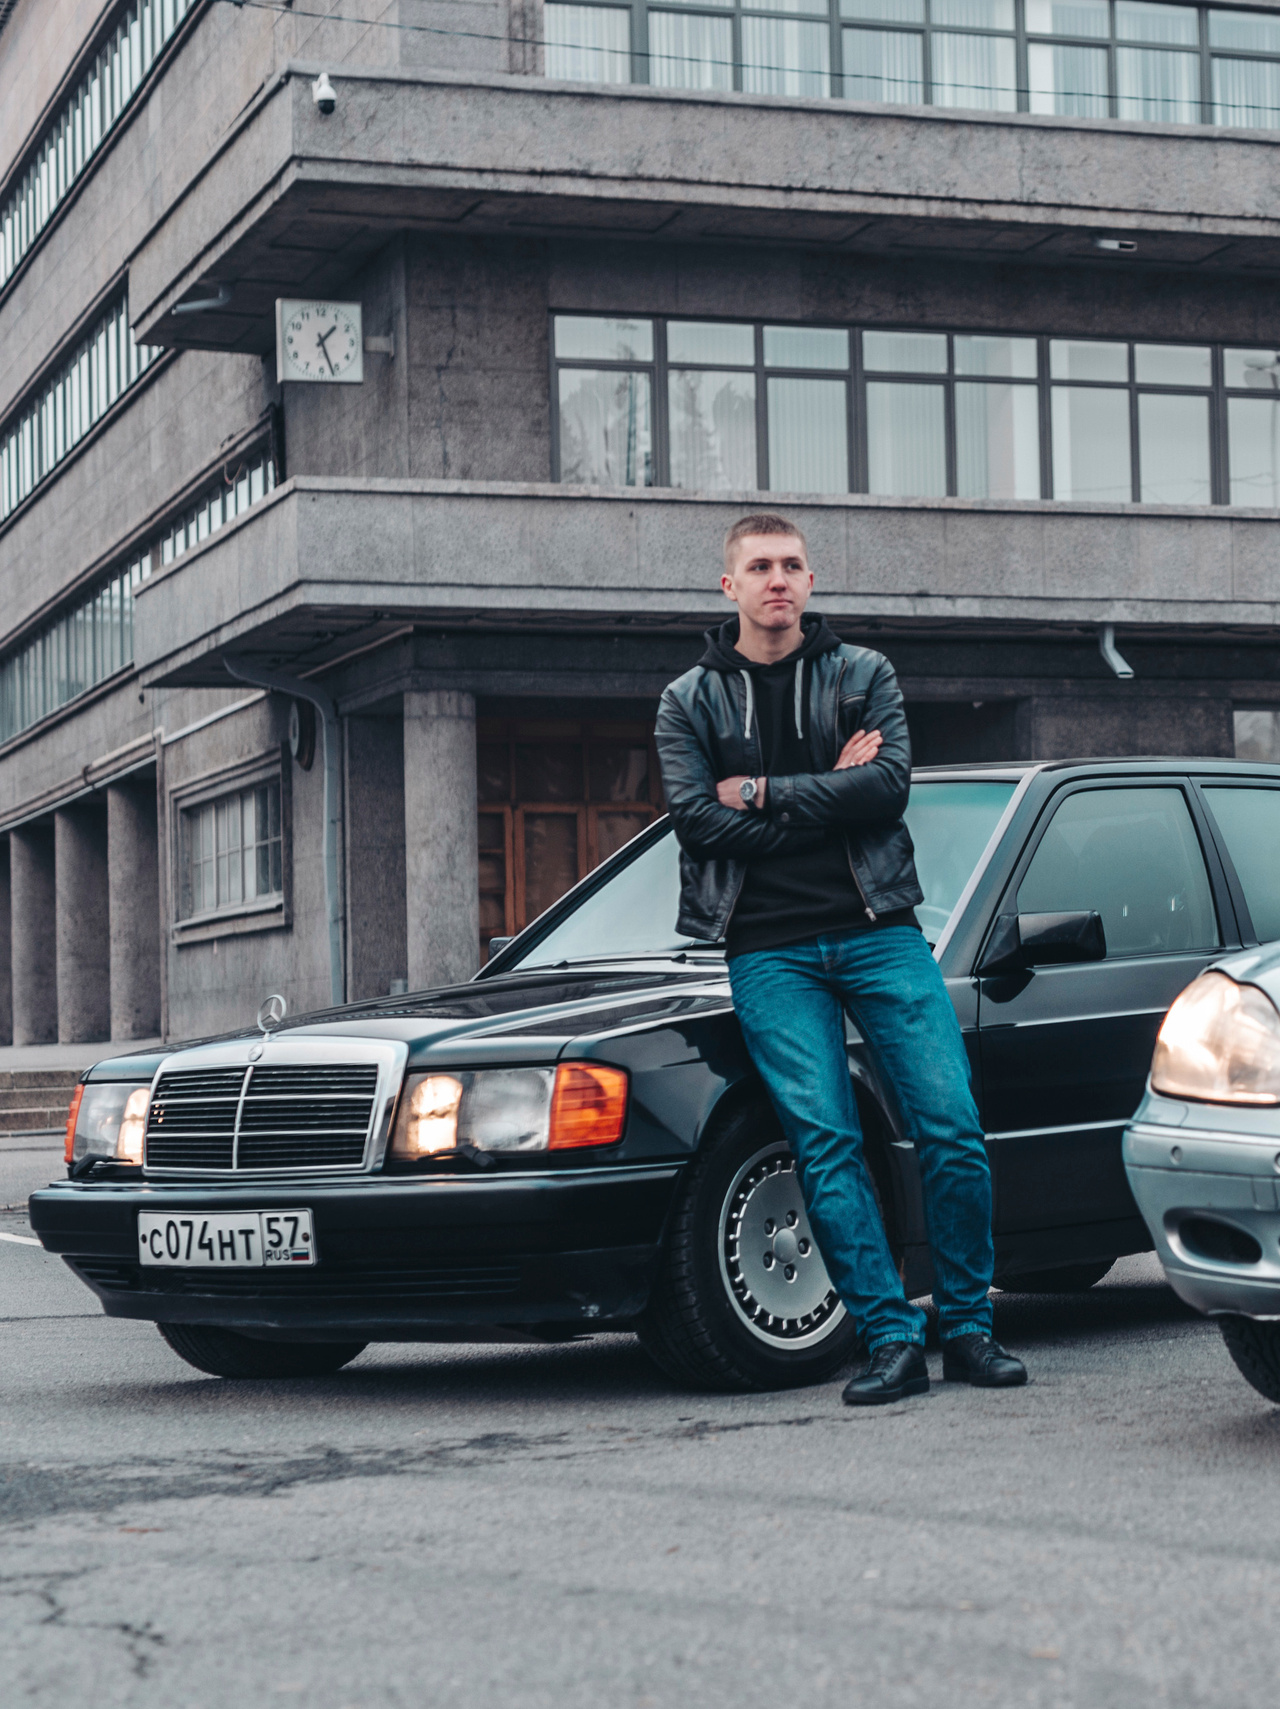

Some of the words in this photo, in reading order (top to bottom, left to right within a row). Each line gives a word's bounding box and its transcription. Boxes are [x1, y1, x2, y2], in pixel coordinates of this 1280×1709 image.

[316, 308, 326, 316] 12
[292, 322, 302, 330] 10
[266, 1216, 299, 1248] 57
[265, 1250, 290, 1261] RUS
